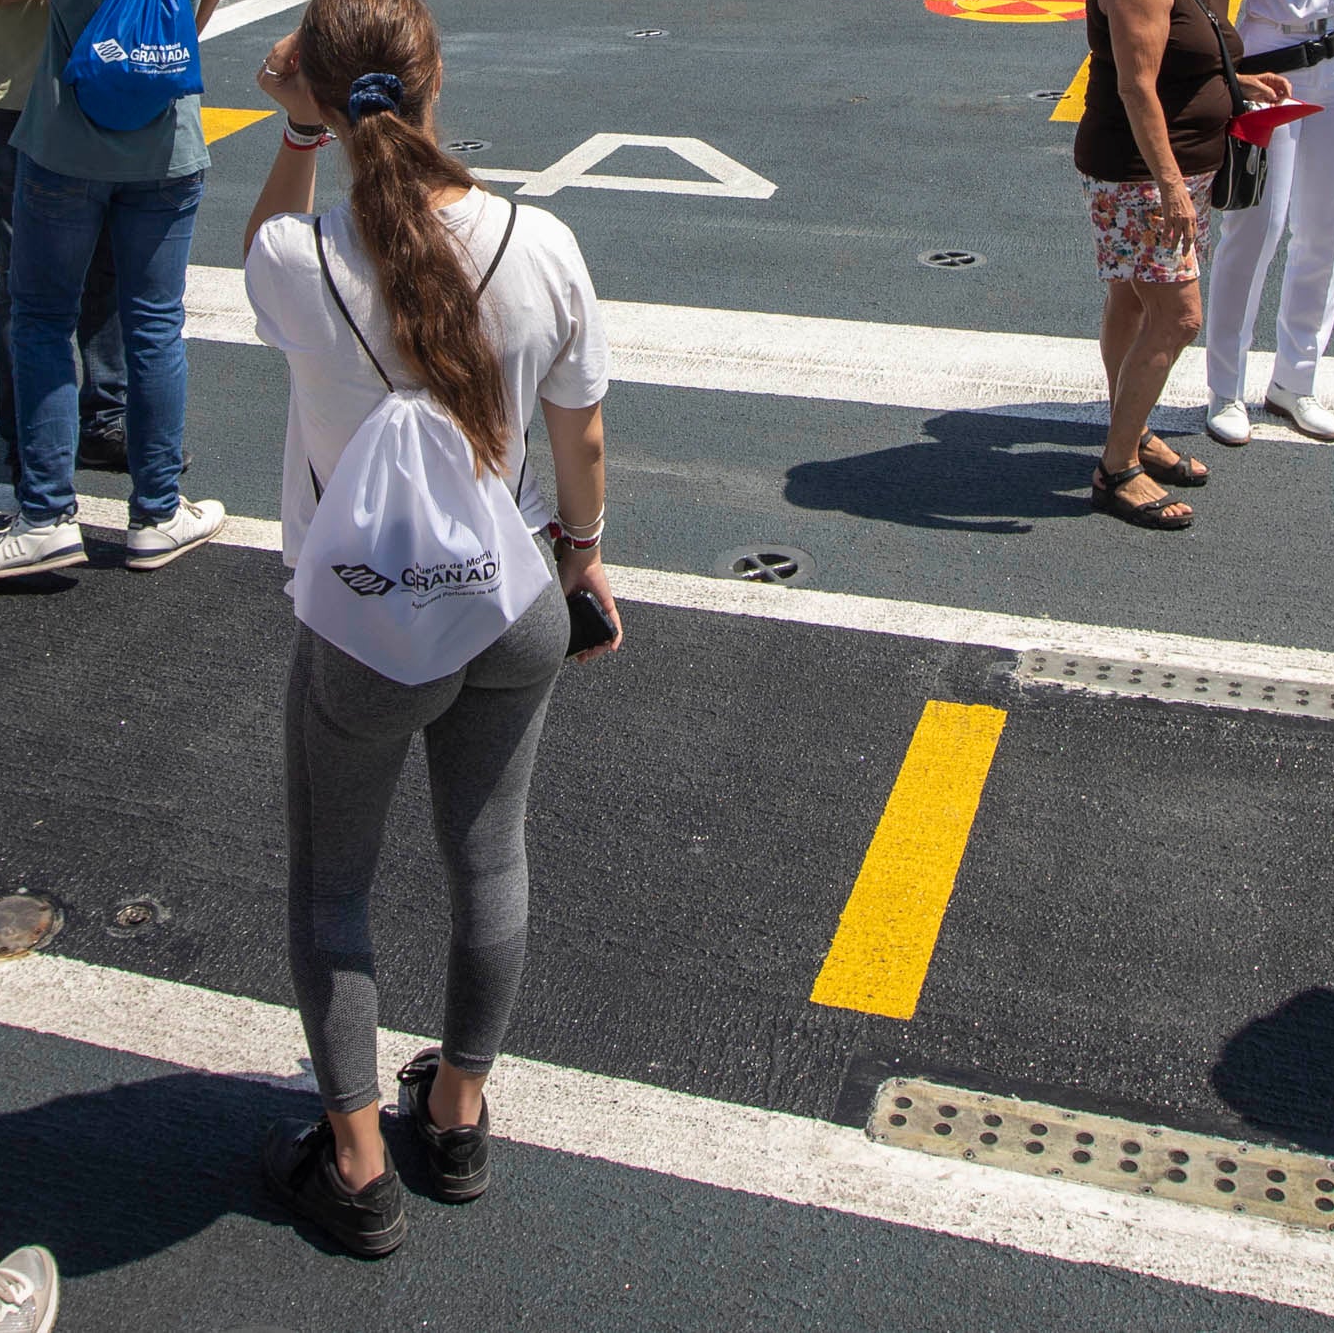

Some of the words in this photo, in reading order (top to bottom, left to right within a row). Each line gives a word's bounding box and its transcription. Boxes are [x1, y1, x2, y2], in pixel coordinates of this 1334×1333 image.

[130, 47, 190, 63] GRANADA
[449, 562, 463, 570] de
[466, 549, 493, 568] Motril
[401, 551, 500, 592] GRANAD
